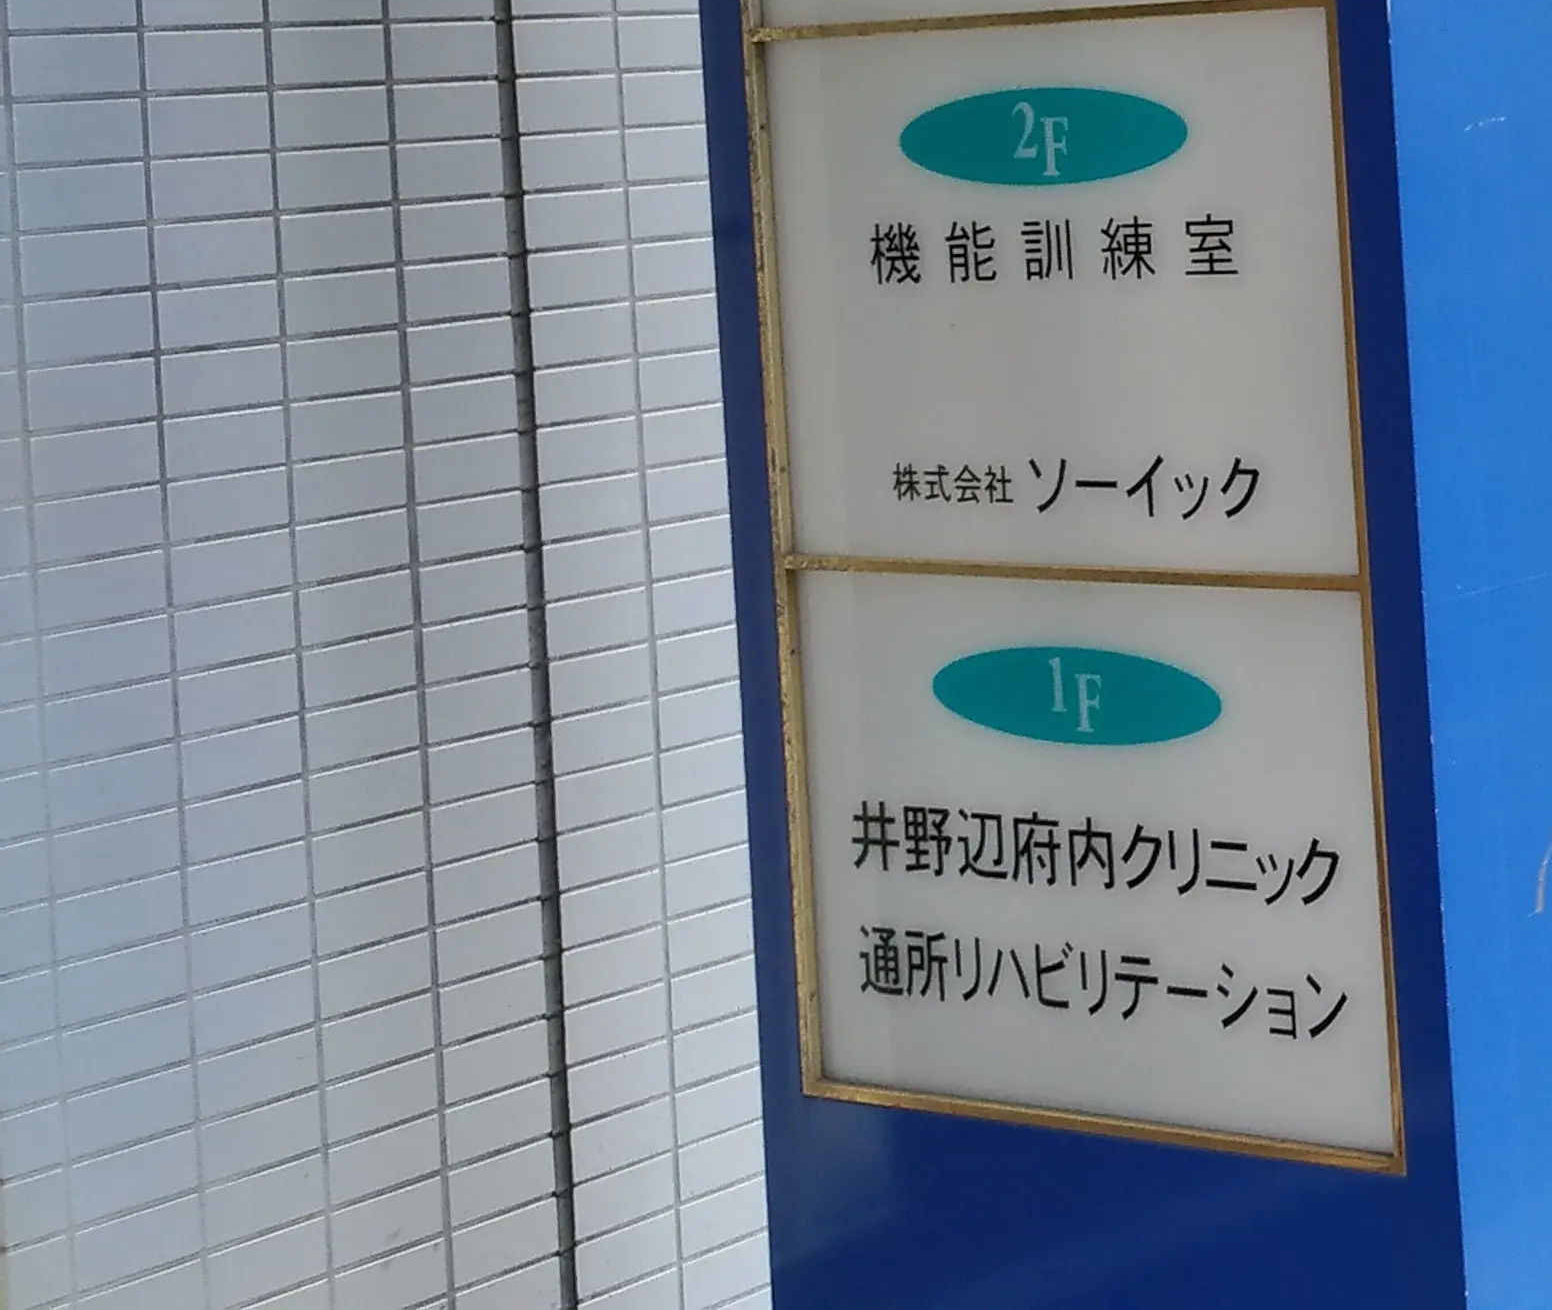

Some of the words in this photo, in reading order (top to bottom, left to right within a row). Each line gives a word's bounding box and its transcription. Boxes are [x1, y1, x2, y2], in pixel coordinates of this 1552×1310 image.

[1011, 101, 1069, 177] 2F
[870, 213, 1239, 285] 機能訓練室
[1048, 656, 1101, 733] 1F
[851, 799, 1340, 906] 井野辺府内クリニック
[860, 925, 1347, 1039] 通所リハビリテーション
